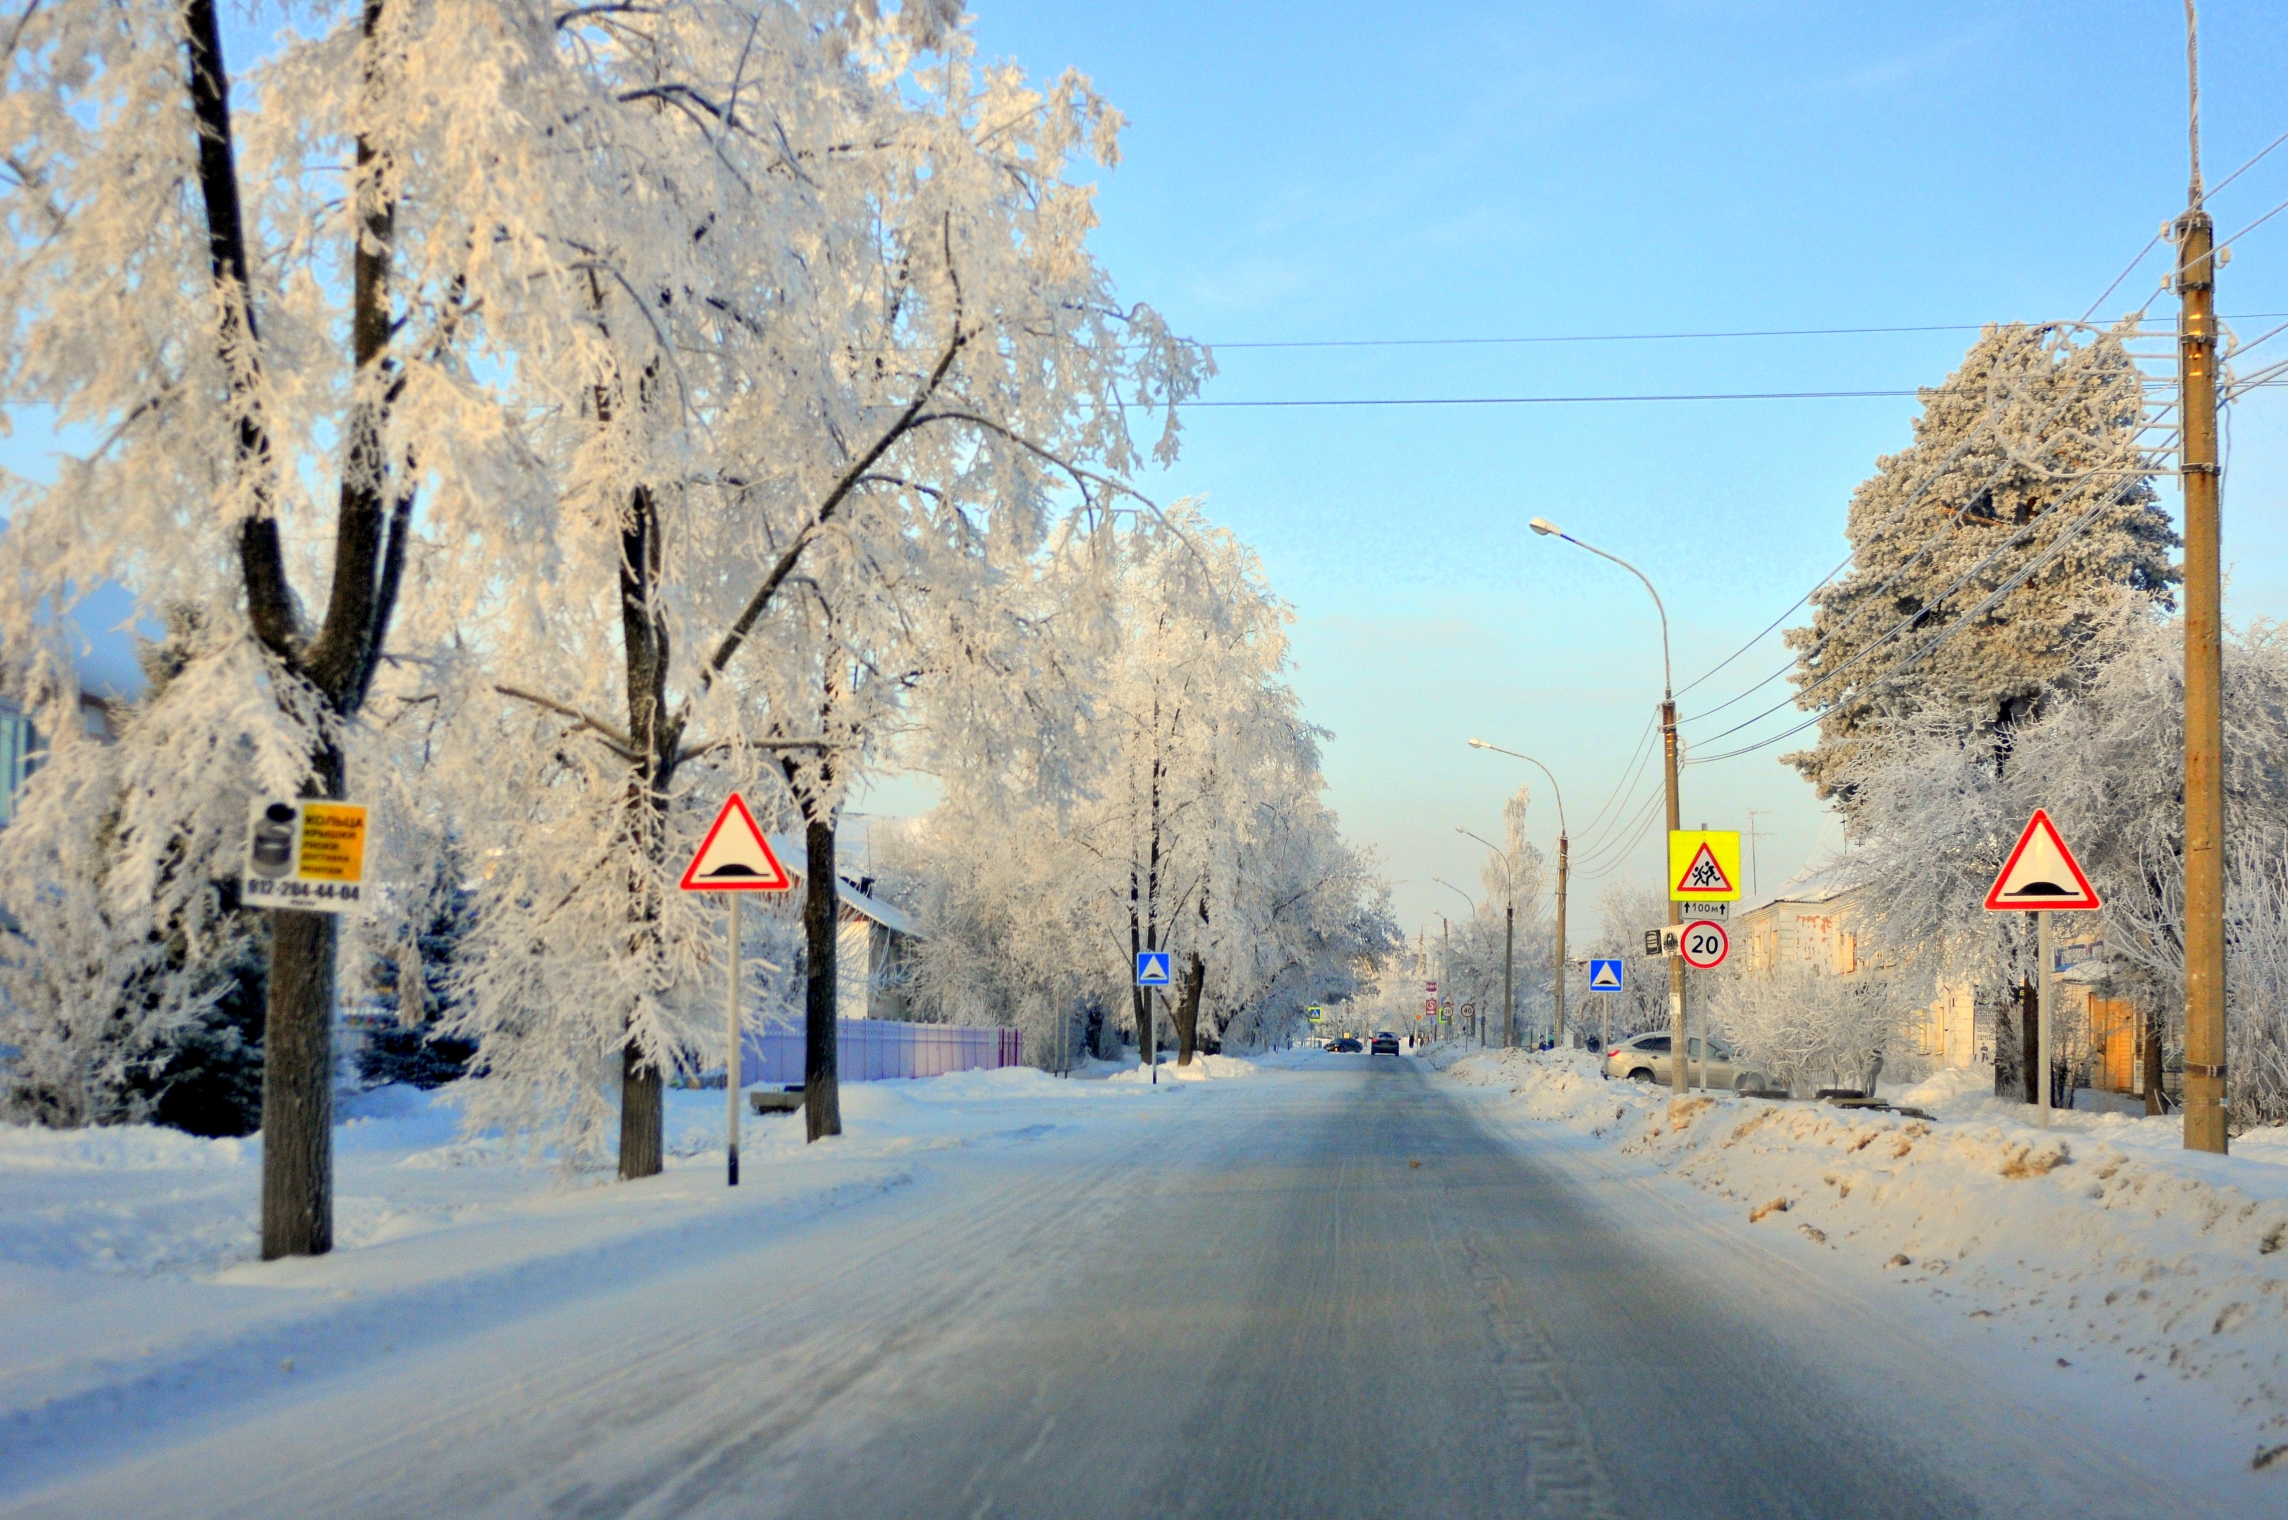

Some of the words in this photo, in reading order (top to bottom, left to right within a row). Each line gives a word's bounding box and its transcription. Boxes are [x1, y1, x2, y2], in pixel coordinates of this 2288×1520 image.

[305, 815, 363, 828] КОЛЬЦА
[304, 829, 356, 839] КРЫШКИ
[1692, 903, 1718, 912] 100м
[1692, 935, 1718, 954] 20
